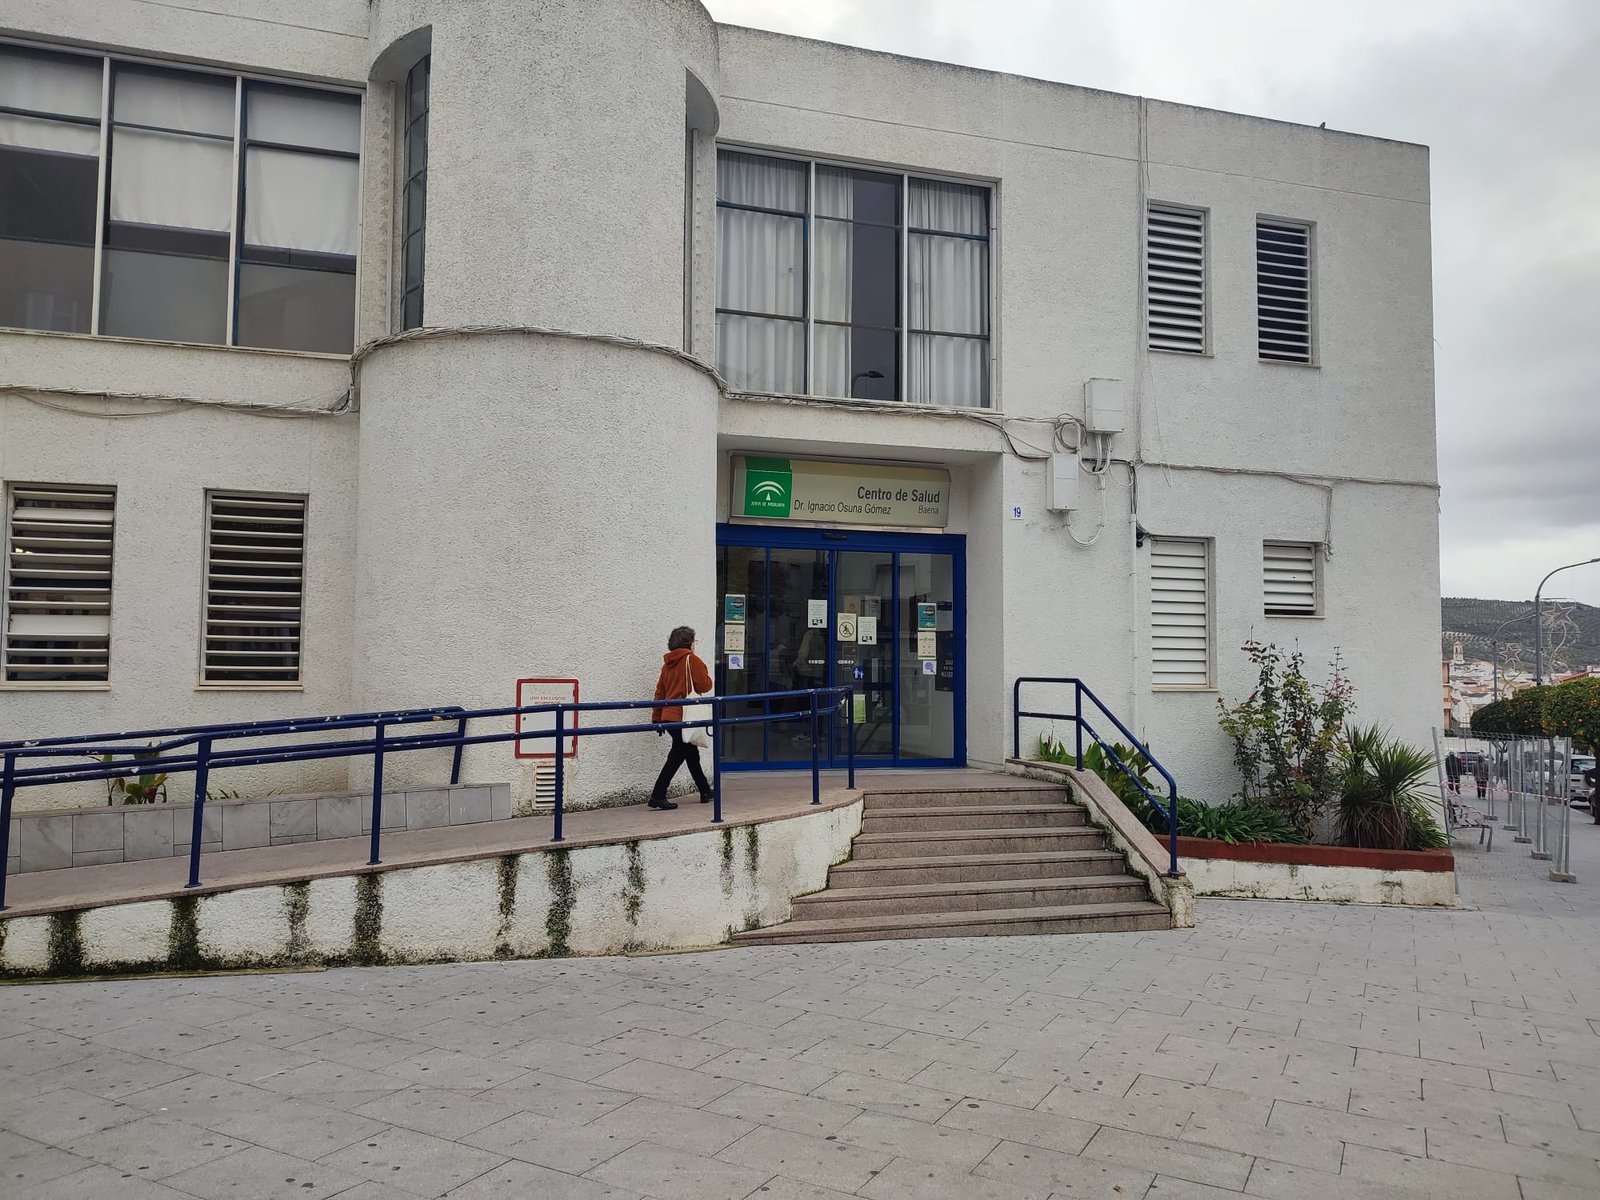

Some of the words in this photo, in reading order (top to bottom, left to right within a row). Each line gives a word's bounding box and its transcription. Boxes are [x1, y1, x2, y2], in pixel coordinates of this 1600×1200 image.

[857, 486, 892, 501] Centro
[895, 488, 908, 502] de
[911, 489, 941, 503] Salud
[793, 499, 805, 511] Dr.
[807, 500, 836, 513] Ignacio
[837, 502, 863, 513] Osuna
[864, 503, 892, 515] Gómez
[917, 504, 940, 515] Baena
[1013, 506, 1022, 518] 19
